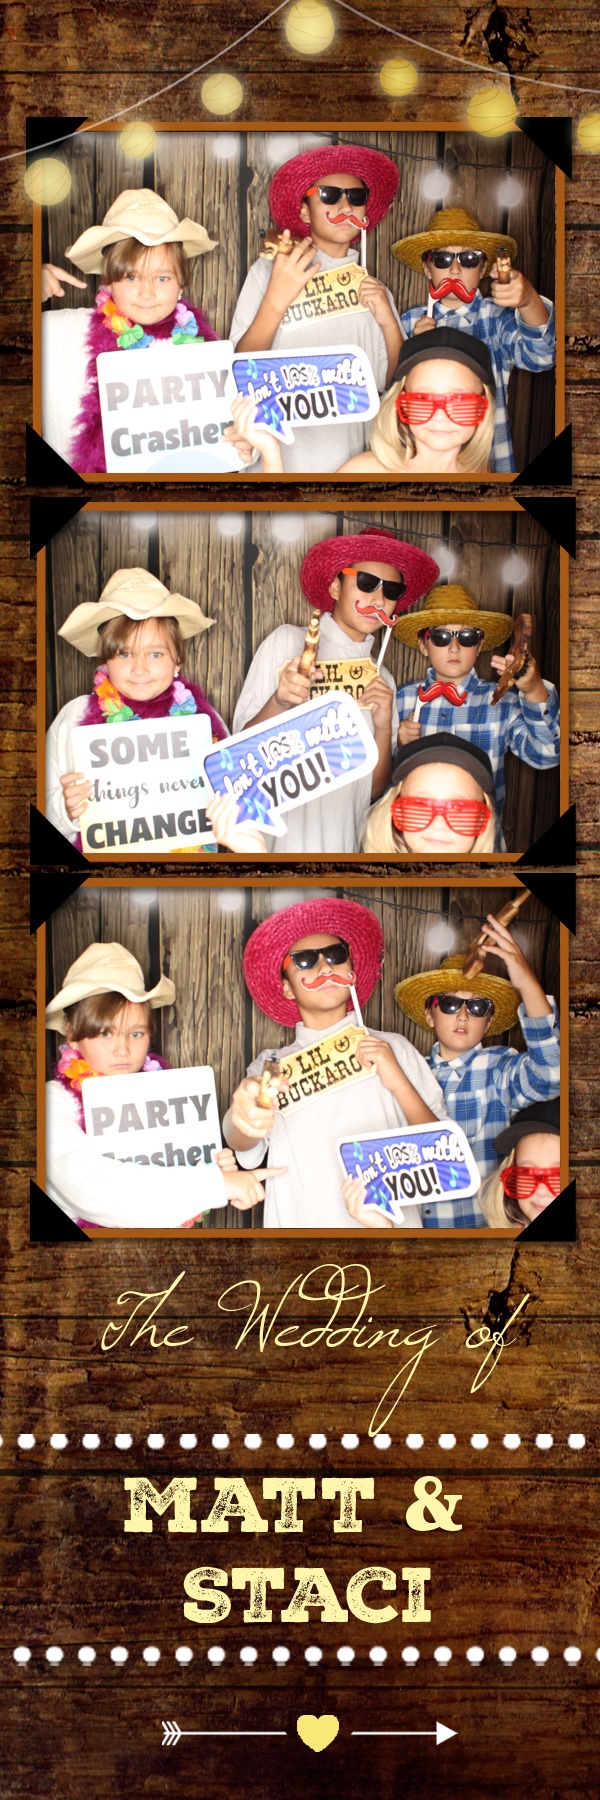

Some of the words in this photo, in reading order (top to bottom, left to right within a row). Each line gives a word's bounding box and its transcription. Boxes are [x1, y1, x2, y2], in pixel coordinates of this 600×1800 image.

[105, 369, 229, 411] PARTY
[321, 357, 366, 386] with
[278, 389, 337, 421] YOU!
[305, 703, 360, 747] with
[89, 730, 190, 768] SOME
[88, 778, 150, 809] hings
[261, 751, 331, 807] YOU!
[86, 808, 213, 849] CHANGE
[91, 1093, 211, 1137] PARTY
[422, 1133, 465, 1162] with
[385, 1166, 441, 1200] YOU!
